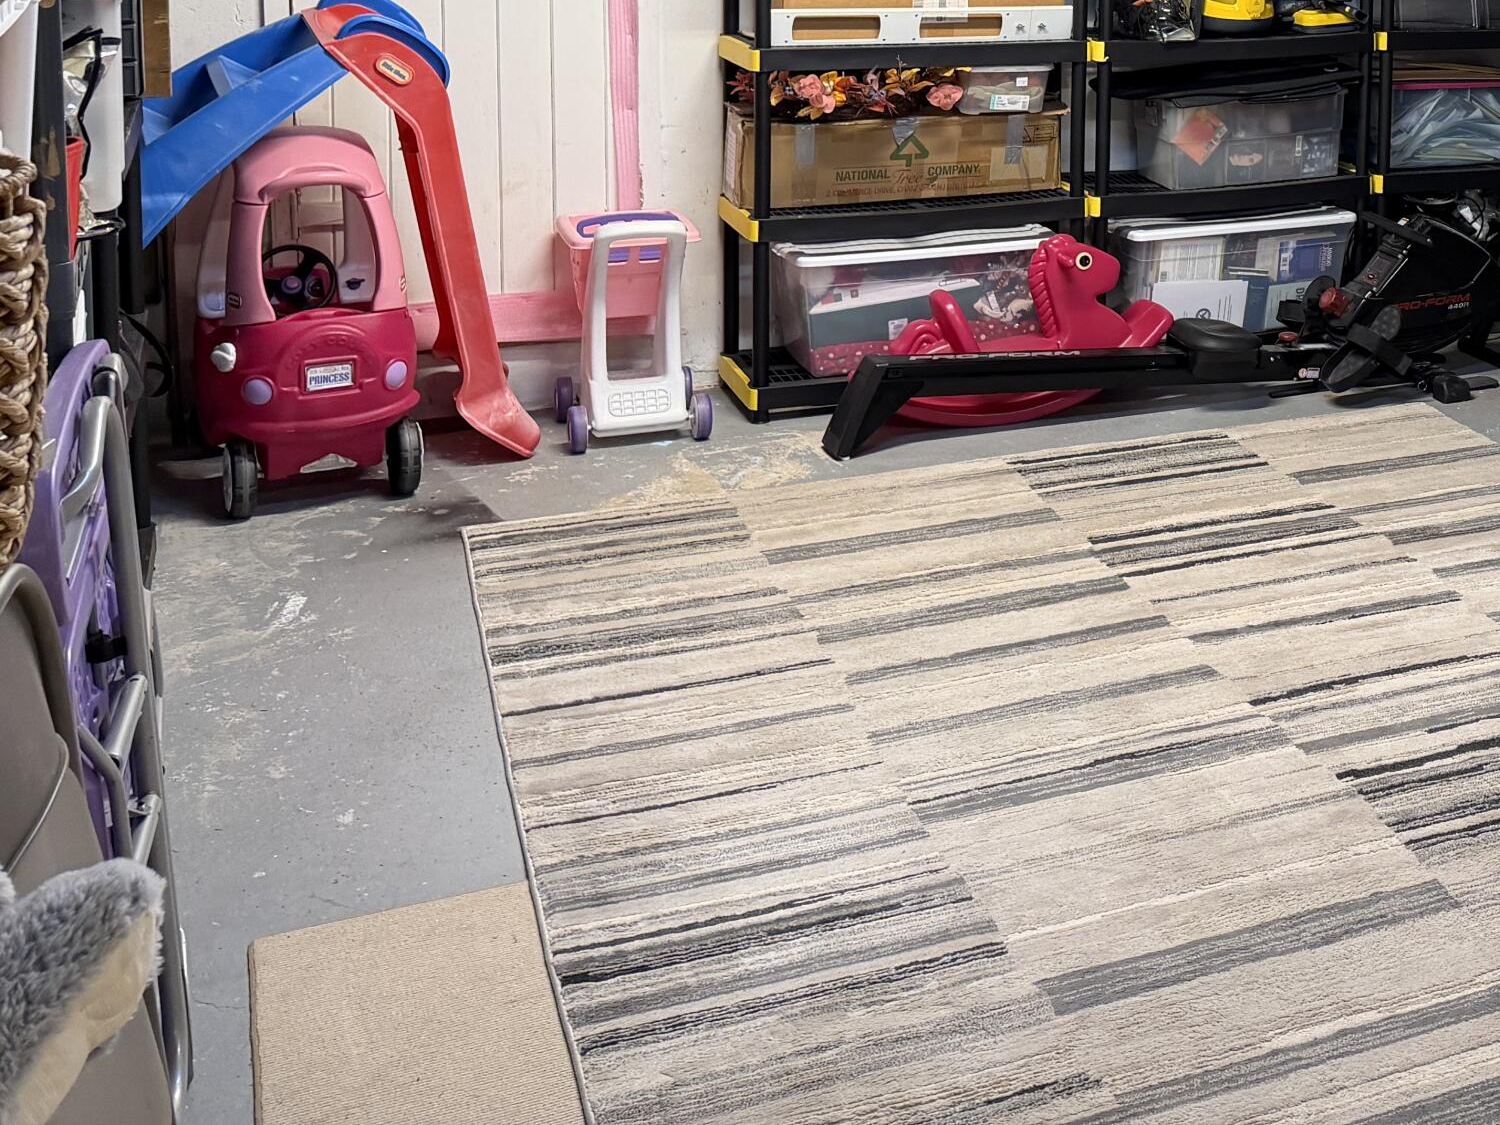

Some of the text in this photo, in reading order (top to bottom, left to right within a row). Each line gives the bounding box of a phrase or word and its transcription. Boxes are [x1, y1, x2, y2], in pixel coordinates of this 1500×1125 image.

[835, 168, 890, 182] NATIONAL
[909, 350, 1081, 361] PRO-FORM
[309, 372, 350, 385] PRINCESS
